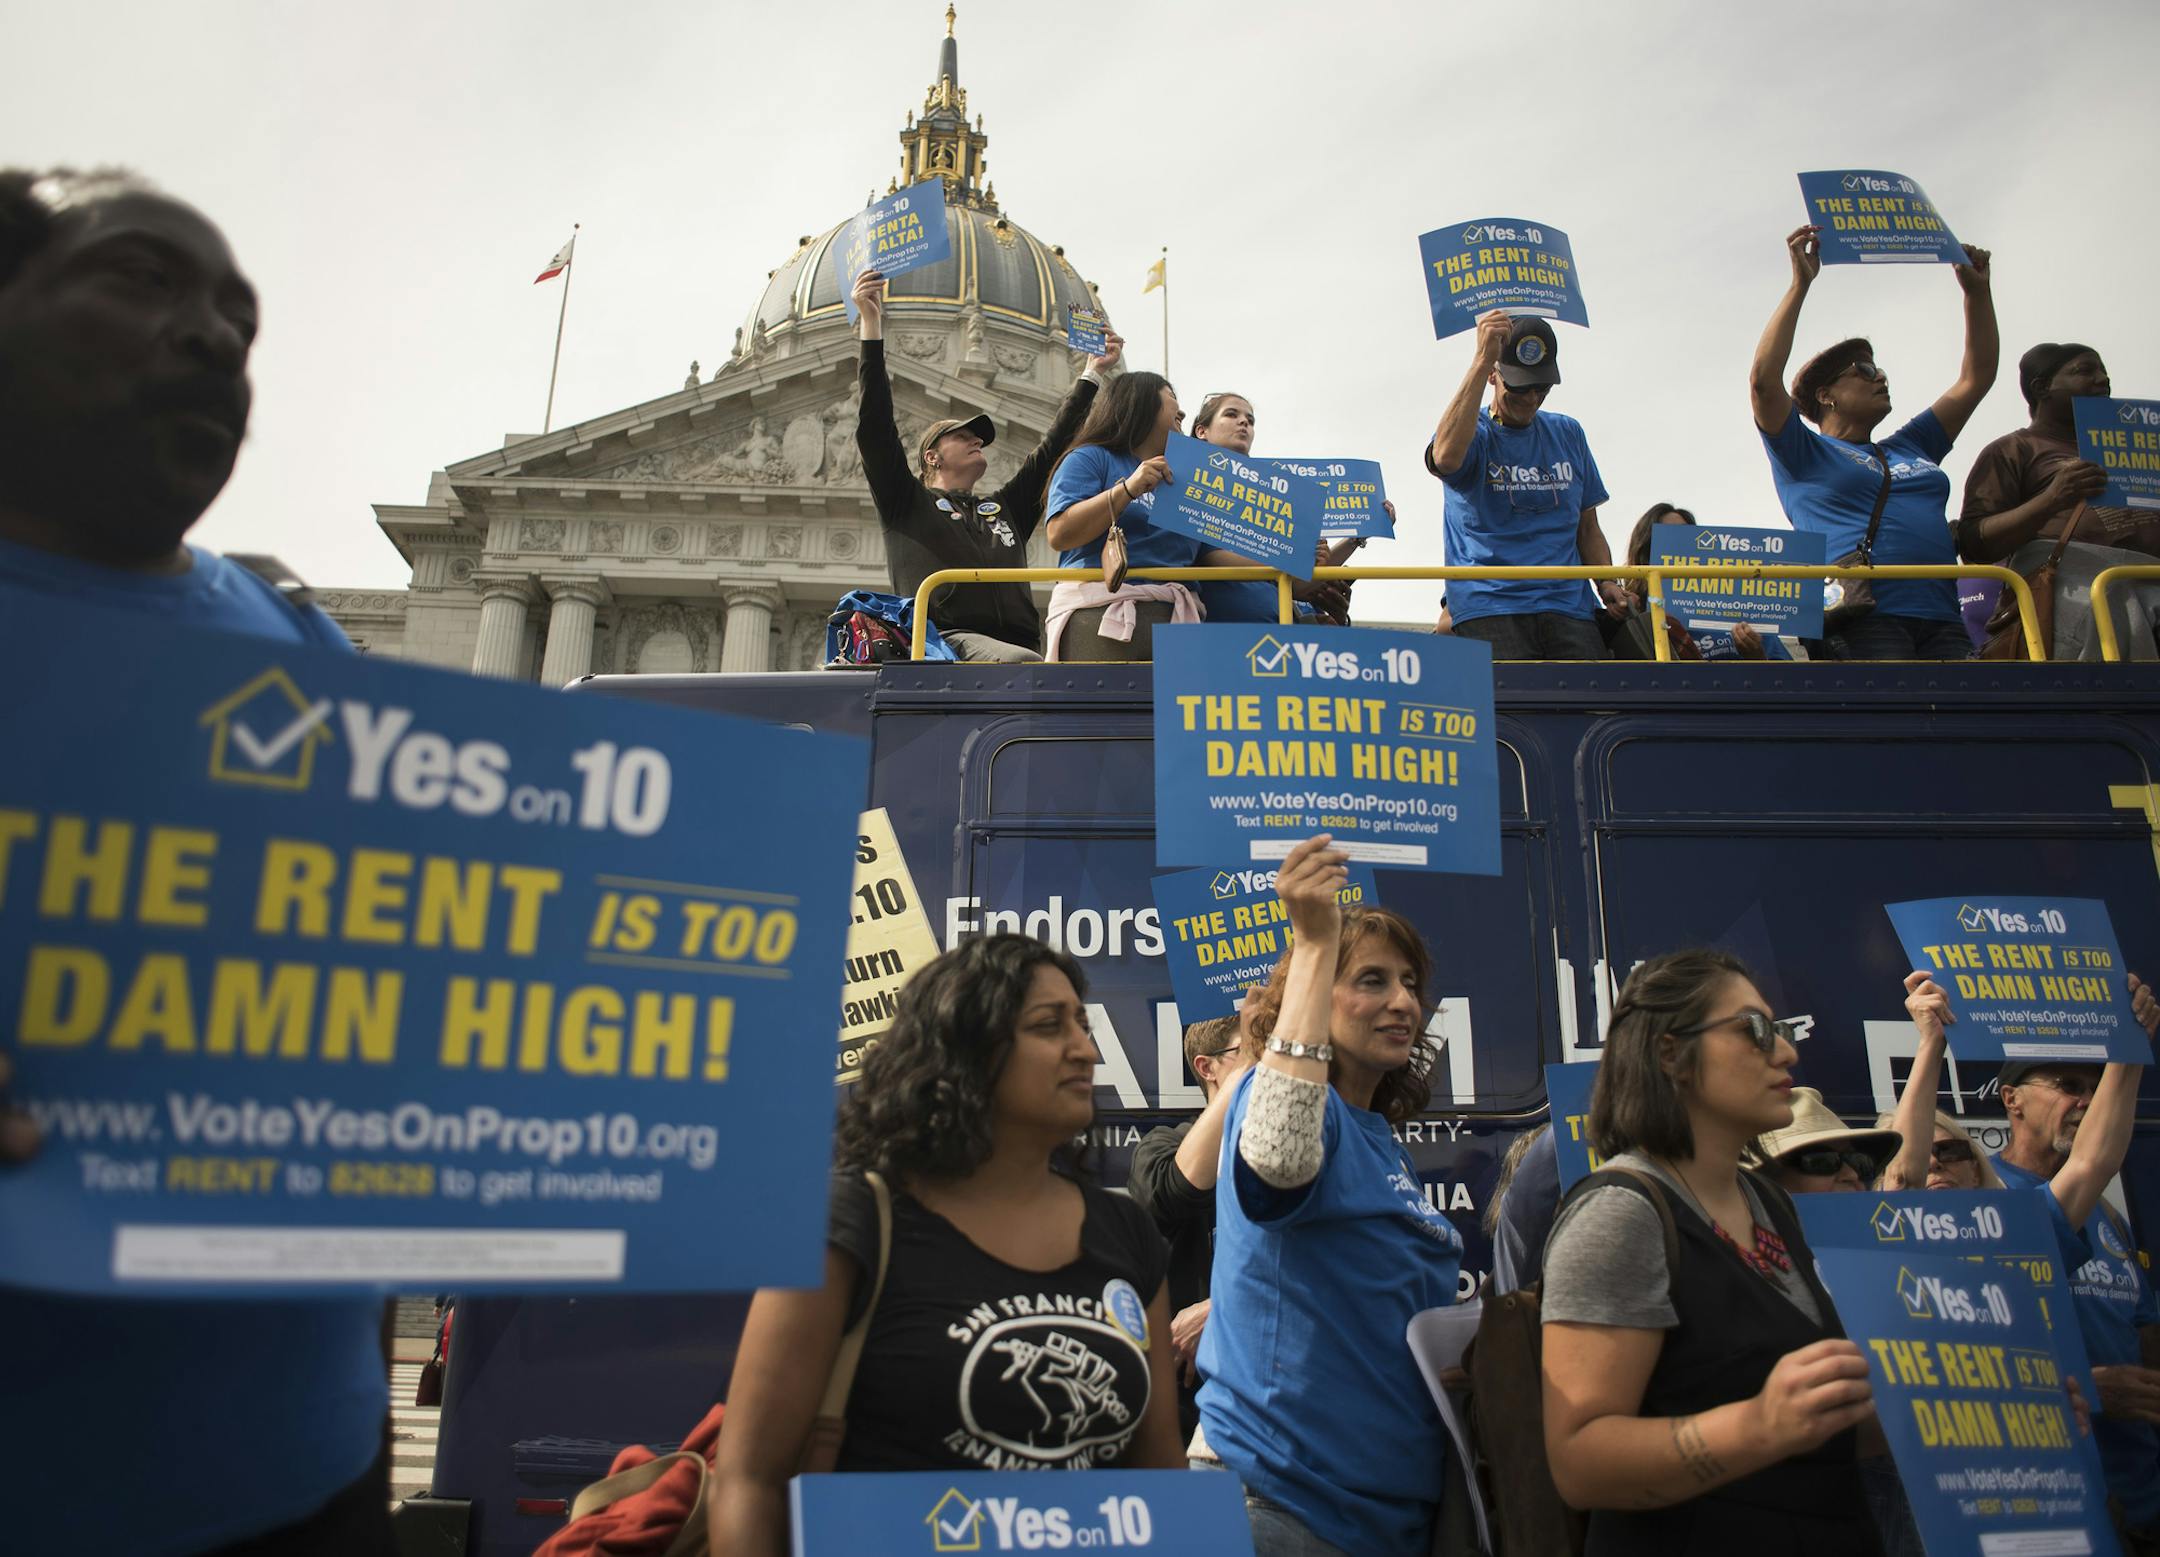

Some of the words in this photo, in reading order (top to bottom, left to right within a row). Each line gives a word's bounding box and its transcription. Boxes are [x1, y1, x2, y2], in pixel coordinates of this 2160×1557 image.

[1860, 176, 1890, 192] Yes
[1898, 180, 1914, 194] 10
[885, 209, 894, 218] on
[893, 198, 909, 213] 10
[1816, 198, 1854, 213] THE
[1858, 198, 1905, 213] RENT
[868, 212, 919, 243] RENTA
[1484, 225, 1516, 242] Yes
[1517, 233, 1527, 242] on
[1525, 228, 1542, 244] 10
[1833, 216, 1890, 230] DAMN
[1893, 216, 1944, 231] HIGH!
[878, 225, 924, 253] ALTA!
[1839, 235, 1948, 245] www.VoteYesOnProp10.org
[1433, 252, 1473, 277] THE
[1479, 247, 1530, 265] RENT
[1536, 253, 1547, 263] IS
[1550, 256, 1569, 270] TOO
[1449, 266, 1510, 294] DAMN
[1516, 266, 1566, 288] HIGH!
[1454, 287, 1567, 308] www.VoteYesOnProp10.org
[2088, 430, 2127, 447] THE
[1288, 464, 1316, 477] Yes
[1327, 464, 1345, 477] 10
[1505, 466, 1540, 482] Yes
[1542, 472, 1557, 481] on
[1552, 462, 1573, 481] 10
[2104, 451, 2160, 471] DAMN
[1229, 459, 1259, 483] Yes
[1259, 479, 1270, 488] on
[1270, 475, 1289, 494] 10
[1338, 483, 1349, 492] IS
[1353, 484, 1375, 492] TOO
[1193, 468, 1224, 492] ¡LA
[1232, 484, 1293, 519] RENTA
[1185, 486, 1201, 500] ES
[1205, 492, 1235, 512] MUY
[1241, 505, 1294, 539] ALTA!
[1179, 504, 1293, 555] www.VoteYesOnProp10.org
[1718, 534, 1750, 551] Yes
[1763, 537, 1783, 553] 10
[1672, 578, 1734, 595] DAMN
[1742, 578, 1801, 598] HIGH!
[1672, 599, 1798, 614] www.VoteYesOnProp10.org
[1762, 612, 1786, 620] involved
[1717, 637, 1731, 645] on
[1293, 642, 1359, 680] Yes
[1362, 668, 1383, 682] on
[1381, 648, 1421, 684] 10
[1176, 695, 1262, 731] THE
[1277, 696, 1386, 734] RENT
[1400, 709, 1424, 732] IS
[1433, 714, 1476, 737] TOO
[341, 699, 511, 817] Yes
[508, 780, 572, 828] on
[573, 740, 673, 837] 10
[1206, 741, 1337, 777] DAMN
[1352, 744, 1459, 786] HIGH!
[1209, 792, 1458, 821] www.VoteYesOnProp10.org
[1234, 815, 1260, 828] Text
[1264, 815, 1302, 827] RENT
[1306, 815, 1317, 827] to
[1321, 815, 1357, 828] 82628
[1360, 818, 1370, 830] to
[1373, 819, 1390, 834] get
[1393, 819, 1438, 834] involved
[1237, 870, 1279, 894] Yes
[255, 839, 561, 956] RENT
[589, 891, 664, 953] IS
[681, 901, 800, 966] TOO
[1174, 911, 1227, 942] THE
[1233, 898, 1289, 930] REN
[1983, 908, 2029, 933] Yes
[2030, 923, 2045, 934] on
[2039, 910, 2067, 934] 10
[1196, 930, 1277, 967] DAMN
[1923, 945, 1984, 969] THE
[1987, 944, 2054, 970] RENT
[2064, 951, 2079, 966] IS
[2083, 951, 2112, 968] TOO
[1221, 984, 1237, 994] Text
[1955, 974, 2035, 1002] DAMN
[2044, 976, 2113, 1003] HIGH!
[18, 945, 404, 1064] DAMN
[440, 975, 736, 1082] HIGH!
[1969, 1011, 2118, 1027] www.VoteYesOnProp10.org
[1987, 1025, 2003, 1034] Text
[2004, 1026, 2026, 1035] RENT
[2028, 1027, 2036, 1035] to
[2061, 1027, 2068, 1035] to
[2069, 1028, 2080, 1037] get
[28, 1093, 719, 1170] www.VoteYesOnProp10.org
[81, 1153, 158, 1192] Text
[167, 1156, 277, 1192] RENT
[285, 1161, 321, 1195] to
[442, 1166, 473, 1197] to
[480, 1169, 532, 1205] get
[538, 1171, 663, 1202] involved
[1903, 1207, 1956, 1240] Yes
[1959, 1226, 1977, 1239] on
[1972, 1206, 2003, 1239] 10
[2116, 1275, 2131, 1285] on
[1923, 1276, 1976, 1324] Yes
[1982, 1284, 2012, 1326] 10
[947, 1302, 998, 1344] SAN
[999, 1292, 1107, 1320] FRANCI
[1976, 1307, 1991, 1323] on
[1868, 1339, 1940, 1386] THE
[1936, 1343, 2012, 1389] RENT
[2015, 1356, 2032, 1384] IS
[2035, 1358, 2059, 1387] TOO
[1912, 1399, 2003, 1447] DAMN
[2000, 1403, 2072, 1449] HIGH!
[985, 1498, 1073, 1549] Yes
[1077, 1526, 1105, 1547] on
[1100, 1496, 1151, 1547] 10
